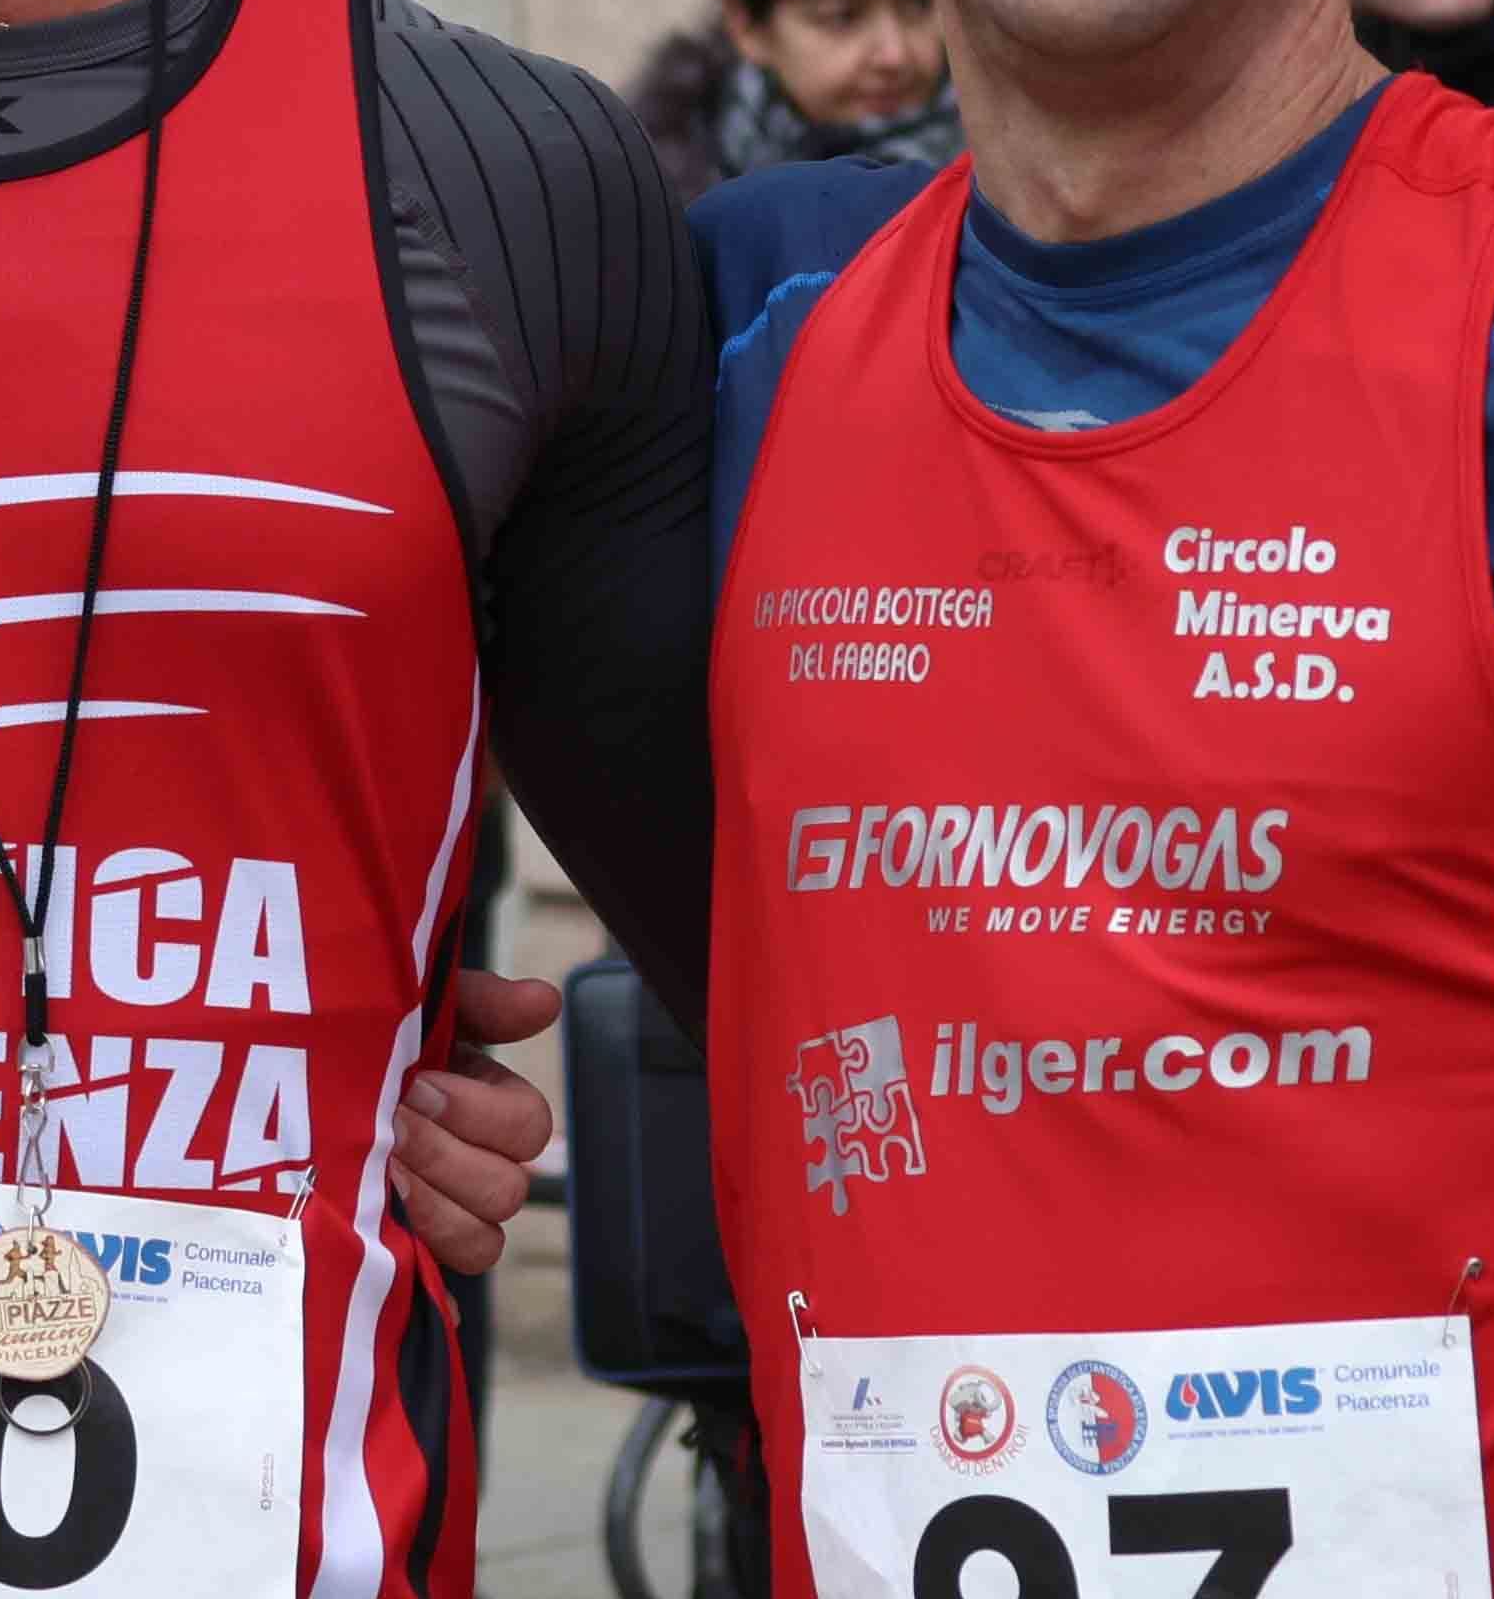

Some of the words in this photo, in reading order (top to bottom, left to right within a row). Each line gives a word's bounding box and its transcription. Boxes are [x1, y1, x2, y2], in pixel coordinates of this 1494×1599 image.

[1163, 525, 1338, 574] Circolo
[753, 589, 776, 631] LA
[776, 586, 870, 629] PICCOLA
[872, 585, 995, 630] BOTTEGA
[1174, 589, 1392, 642] Minerva
[788, 641, 827, 684] DEL
[831, 641, 932, 684] FABBRO
[1192, 650, 1356, 704] A.S.D.
[927, 906, 971, 933] WE
[985, 905, 1092, 933] MOVE
[1106, 906, 1273, 937] ENERGY
[930, 1022, 1373, 1116] ilger.com
[67, 1230, 173, 1287] VIS
[184, 1241, 277, 1269] Comunale
[181, 1271, 264, 1296] Piacenza
[6, 1295, 95, 1326] PIAZZE
[1334, 1359, 1441, 1383] Comunale
[1164, 1365, 1323, 1422] AVIS
[1336, 1391, 1431, 1413] Piacenza
